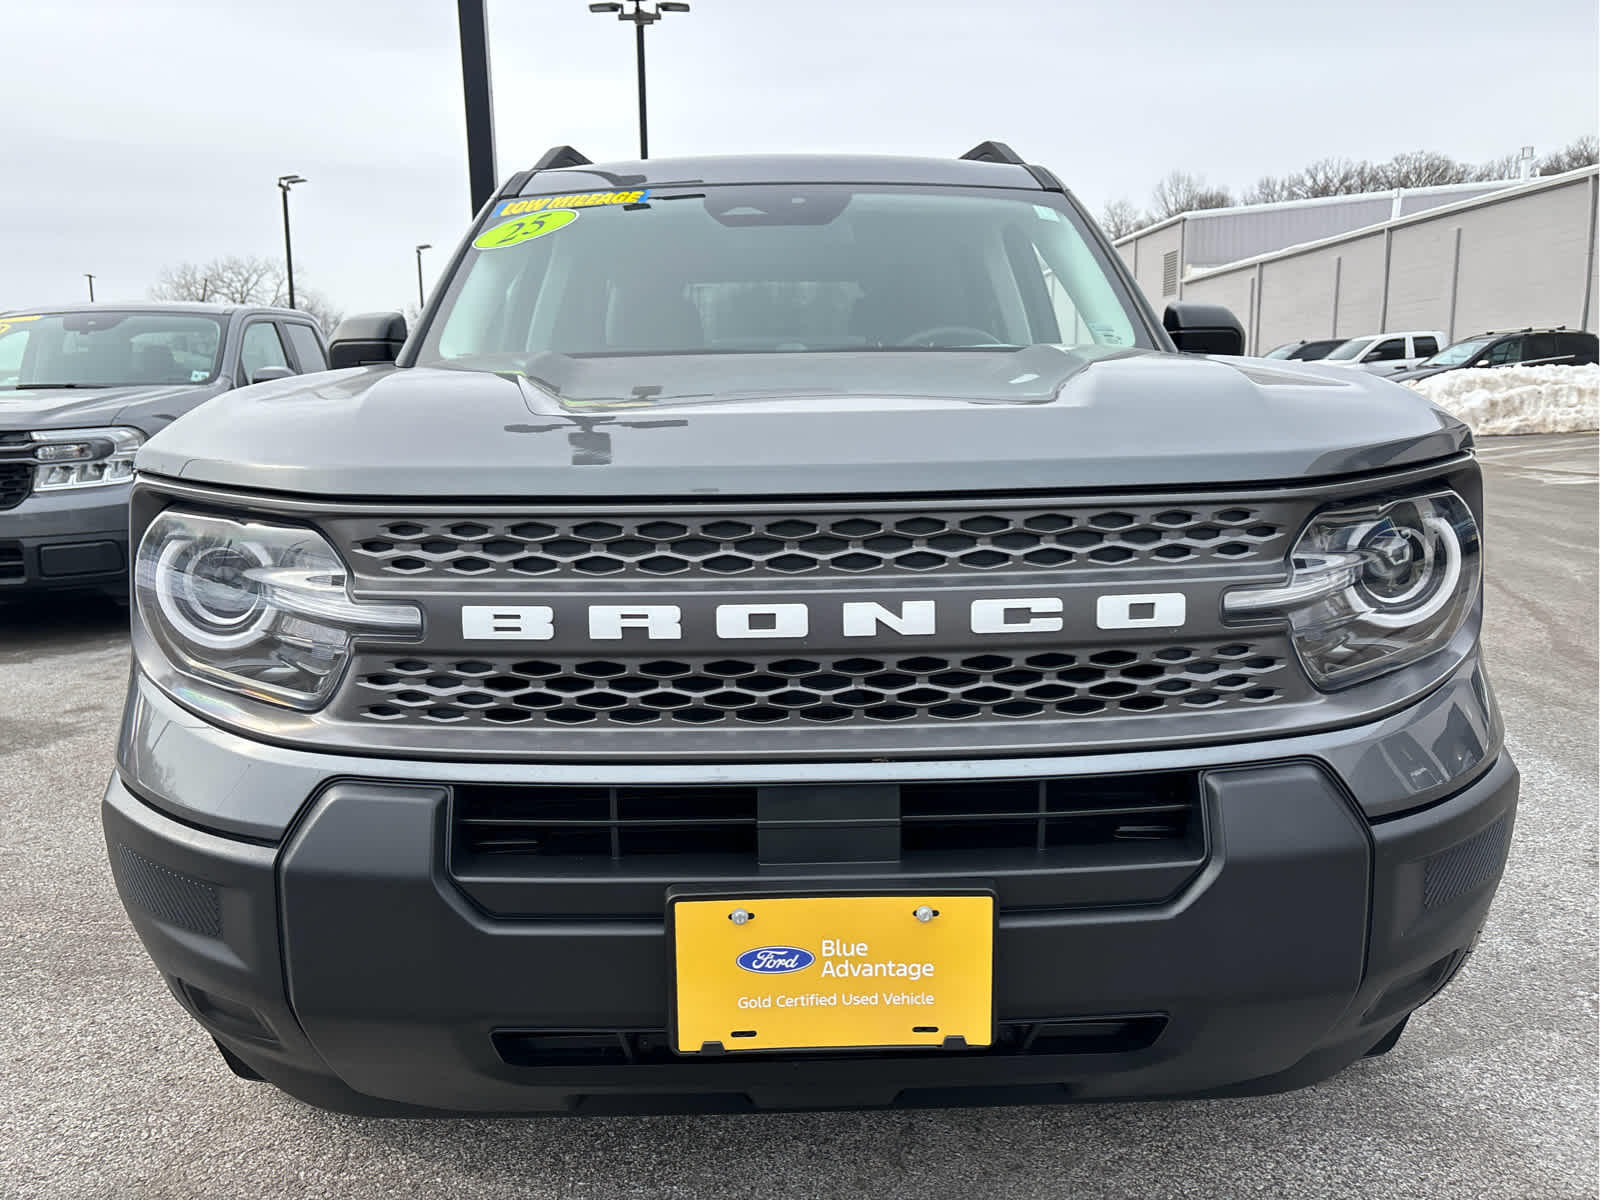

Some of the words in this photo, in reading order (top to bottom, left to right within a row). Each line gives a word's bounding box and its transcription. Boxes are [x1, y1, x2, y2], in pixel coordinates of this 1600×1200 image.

[500, 198, 549, 217] LOW
[547, 191, 645, 209] MILEAGE
[496, 213, 553, 245] 25
[462, 593, 1186, 640] BRONCO
[821, 939, 868, 957] Blue
[752, 950, 799, 969] Ford
[821, 959, 935, 980] Advantage
[737, 996, 772, 1009] Gold
[776, 993, 837, 1008] Certified
[841, 992, 878, 1006] Used
[884, 992, 935, 1005] Vehicle
